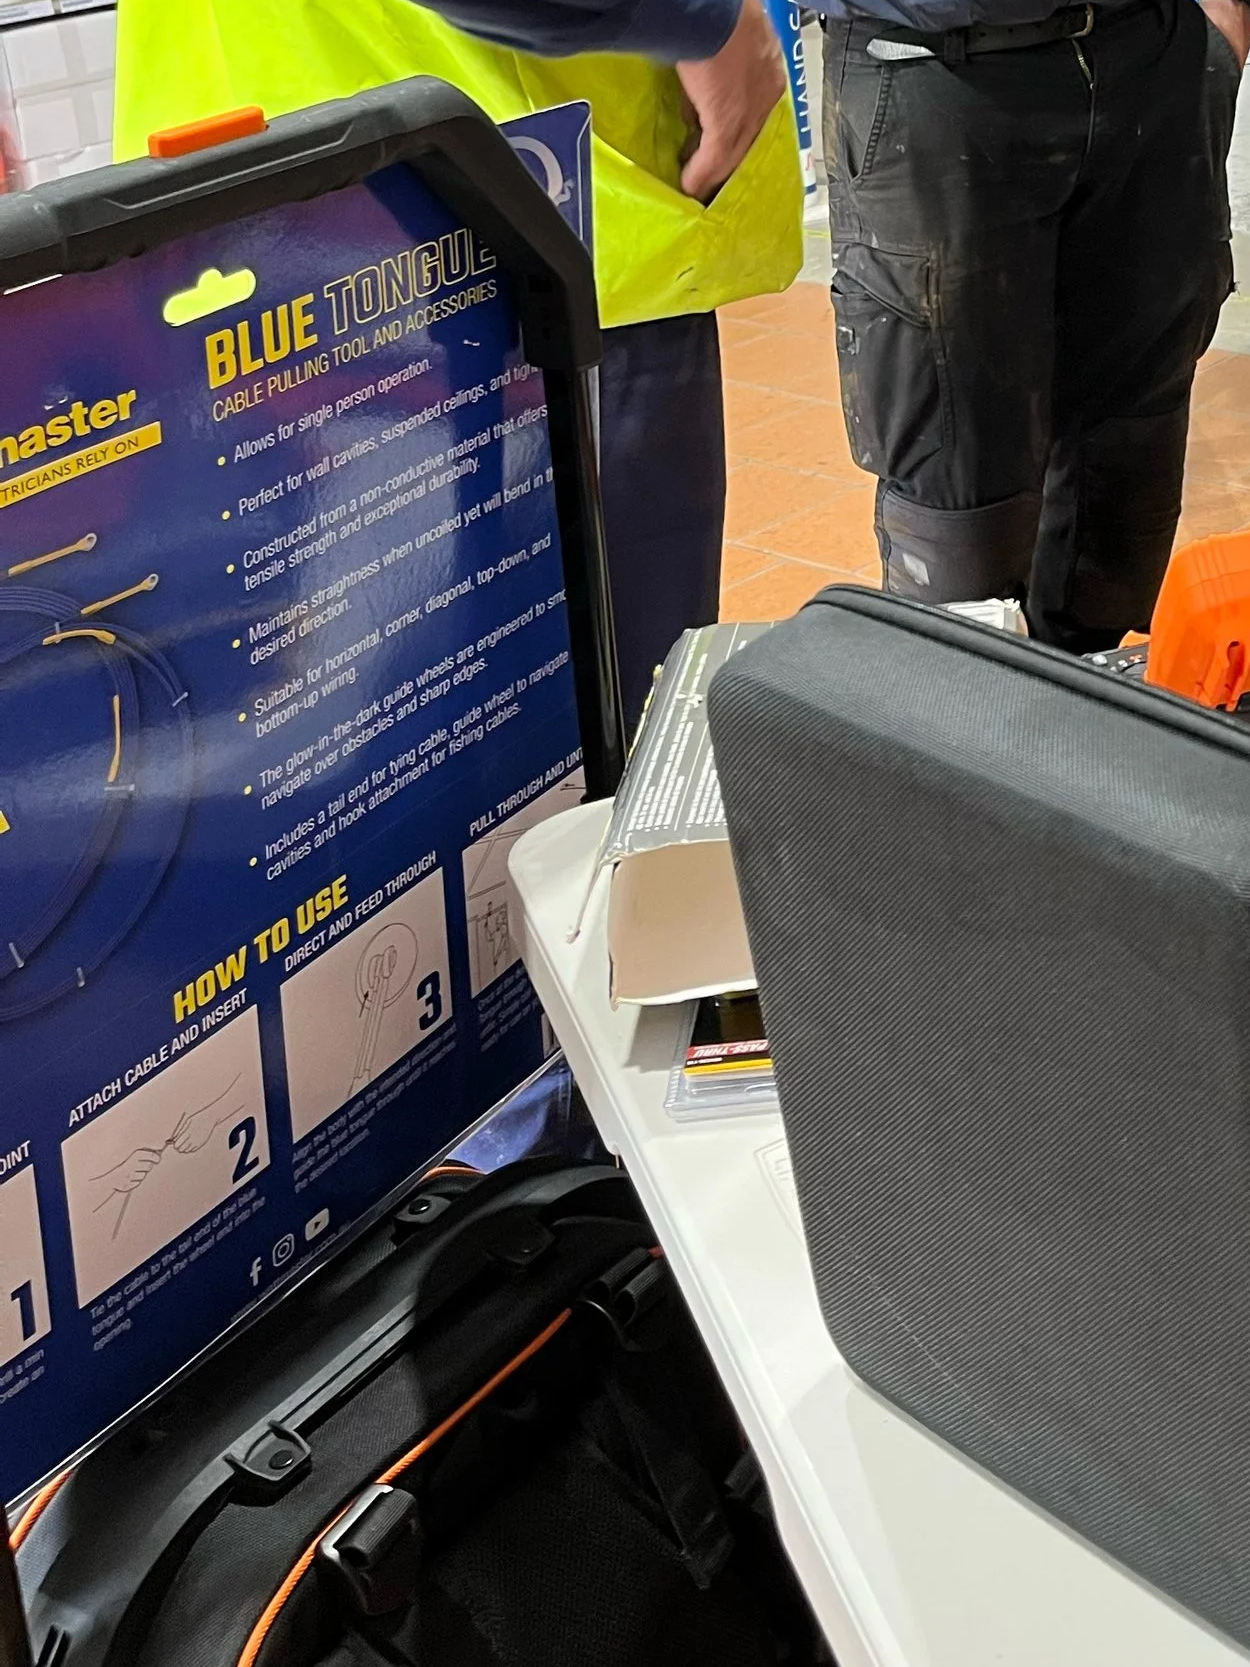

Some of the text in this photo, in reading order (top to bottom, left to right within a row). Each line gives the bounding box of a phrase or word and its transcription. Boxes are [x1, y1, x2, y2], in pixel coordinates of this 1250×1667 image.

[205, 228, 497, 390] BLUE TONGUE
[212, 280, 498, 422] CABLE PULLING TOOL AND ACCESSORIES
[76, 447, 110, 471] RELY
[114, 436, 139, 454] ON
[233, 358, 432, 463] Allows single person operation.
[238, 383, 488, 516] Perfect wall cavities, suspended ceilings,
[243, 404, 548, 569] Constructed from non-conductive material that offers
[244, 457, 480, 591] tensile strength exceptional durability.
[249, 480, 531, 644] Maintains straightness when uncoiled will bend
[250, 598, 352, 665] desired direction.
[254, 548, 530, 717] Suitable horizontal, corner, diagonal, top-down,
[286, 606, 533, 775] glow-in-the-dark guide wheels engineered
[255, 667, 360, 738] bottom-up wiring.
[261, 658, 489, 810] navigate over obstacles sharp edges.
[264, 650, 569, 860] Includes tail tying cable, guide wheel navigate
[266, 702, 522, 881] cavities hook attachment fishing cables.
[469, 760, 566, 837] PULL THROUGH AND
[173, 874, 349, 1025] HOW TO USE
[285, 850, 437, 972] DIRECT AND FEED THROUGH
[68, 988, 249, 1127] ATTACH CABLE AND INSERT
[416, 970, 442, 1031] 3
[227, 1114, 260, 1185] 2
[10, 1279, 36, 1342] 1
